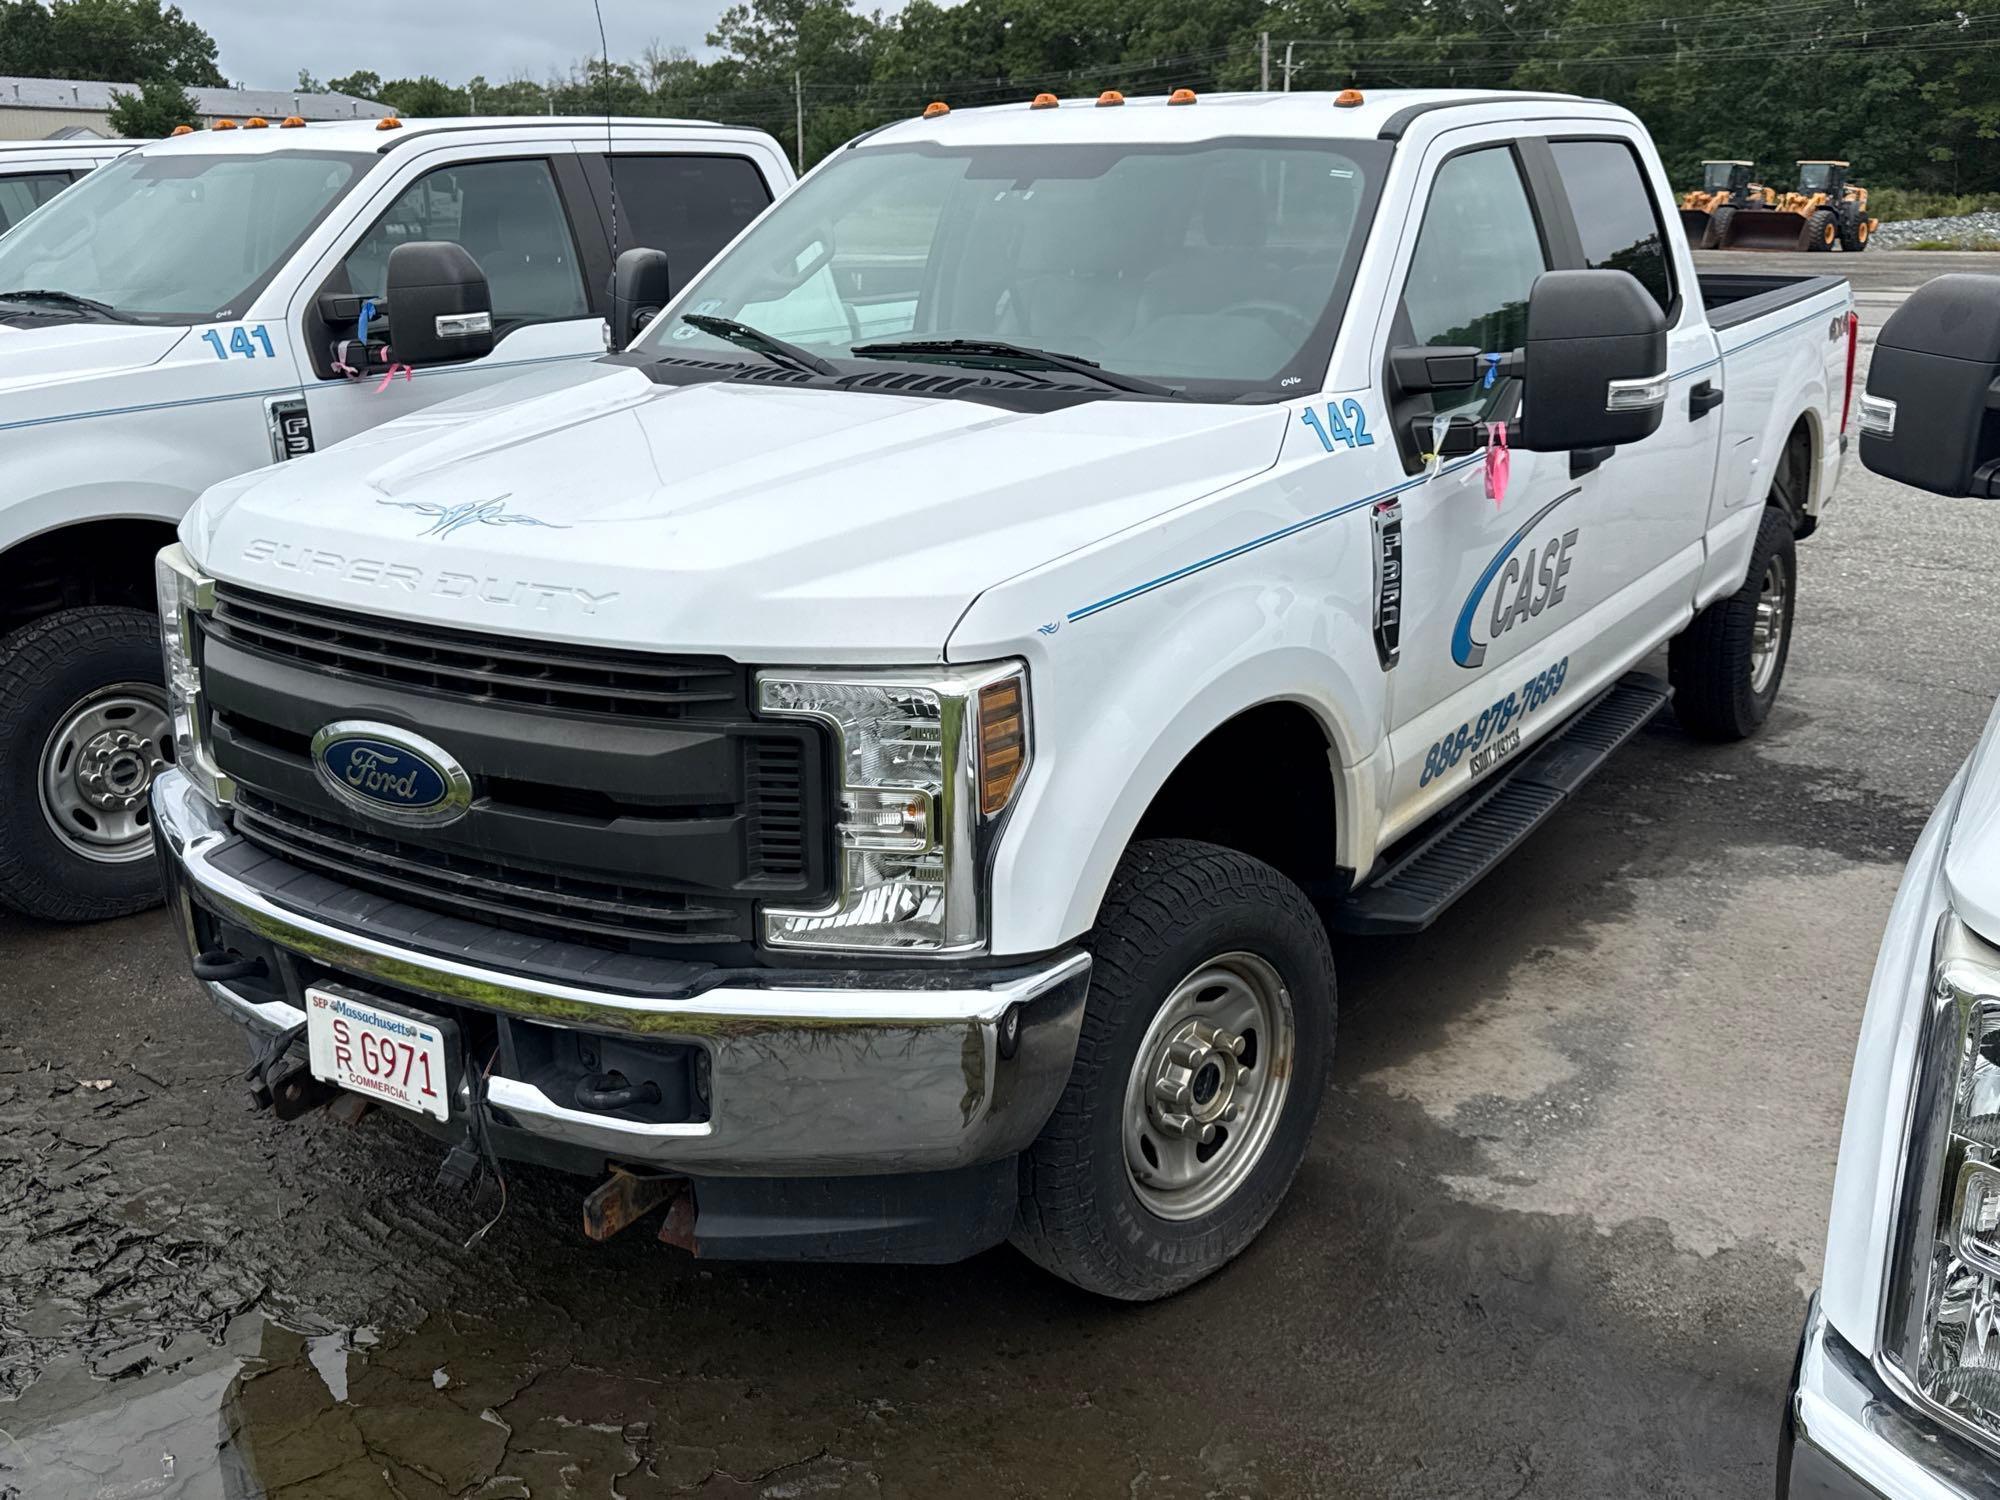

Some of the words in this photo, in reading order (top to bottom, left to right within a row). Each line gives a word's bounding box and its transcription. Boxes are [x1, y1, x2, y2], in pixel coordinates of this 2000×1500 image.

[201, 324, 276, 360] 141
[1301, 398, 1375, 453] 142
[241, 538, 424, 593] SUPER
[430, 571, 620, 616] DUTY
[1490, 528, 1579, 638] CASE
[1419, 656, 1569, 788] 888-978-7669
[346, 747, 418, 799] Ford
[312, 996, 328, 1010] SEP
[335, 1000, 412, 1037] Massachusetts
[349, 1073, 411, 1101] COMMERCIAL
[360, 1031, 438, 1098] G971
